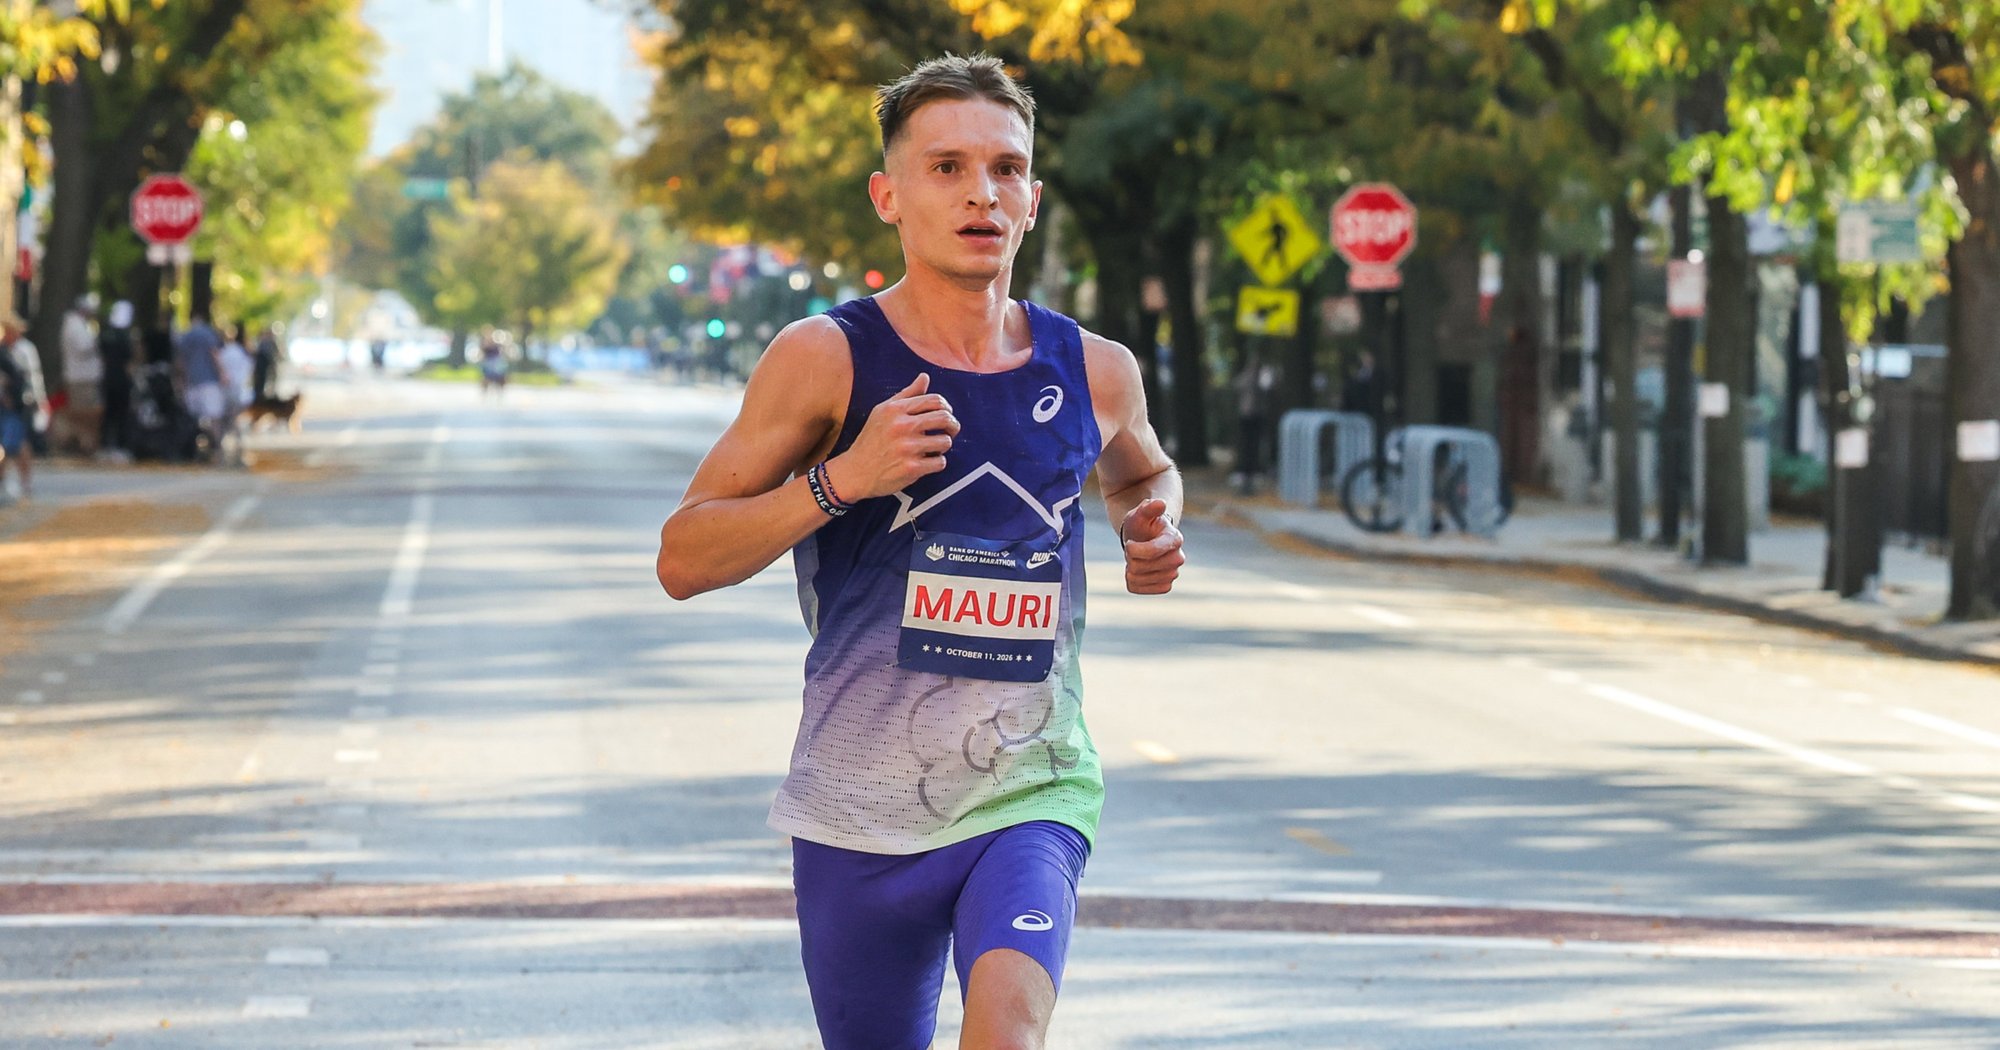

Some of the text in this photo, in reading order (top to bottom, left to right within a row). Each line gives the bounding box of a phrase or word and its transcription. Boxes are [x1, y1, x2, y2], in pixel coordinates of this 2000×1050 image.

[136, 197, 199, 225] STOP
[1338, 210, 1410, 243] STOP
[813, 486, 830, 508] THE
[949, 546, 966, 554] BANK
[1031, 552, 1051, 562] RUN
[948, 553, 1016, 568] CHICAGO MARATHON
[913, 585, 1052, 629] MAURI
[946, 648, 1013, 661] OCTOBER 11, 2026
